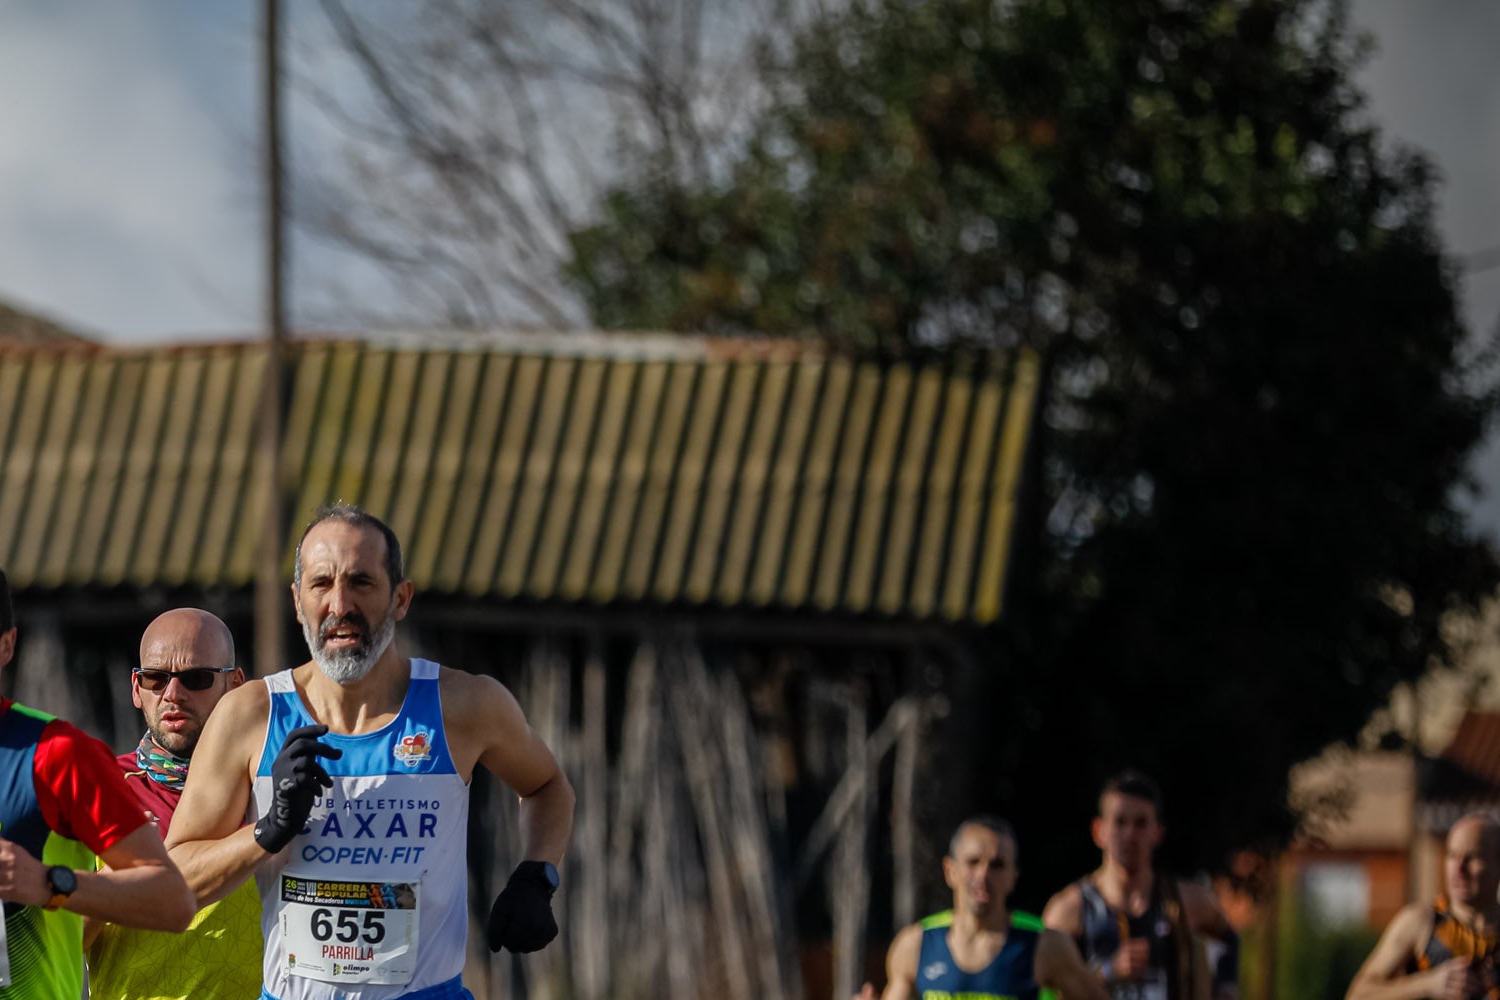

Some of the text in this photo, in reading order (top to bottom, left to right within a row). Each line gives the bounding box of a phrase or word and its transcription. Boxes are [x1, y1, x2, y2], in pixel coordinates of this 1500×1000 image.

[312, 798, 440, 810] UB ATLETISMO
[302, 812, 437, 838] AXAR
[285, 879, 297, 889] 26
[317, 882, 368, 892] CARRERA
[317, 891, 367, 899] POPULAR
[311, 908, 386, 944] 655
[322, 945, 375, 961] PARRILLA
[343, 964, 370, 973] olimpo
